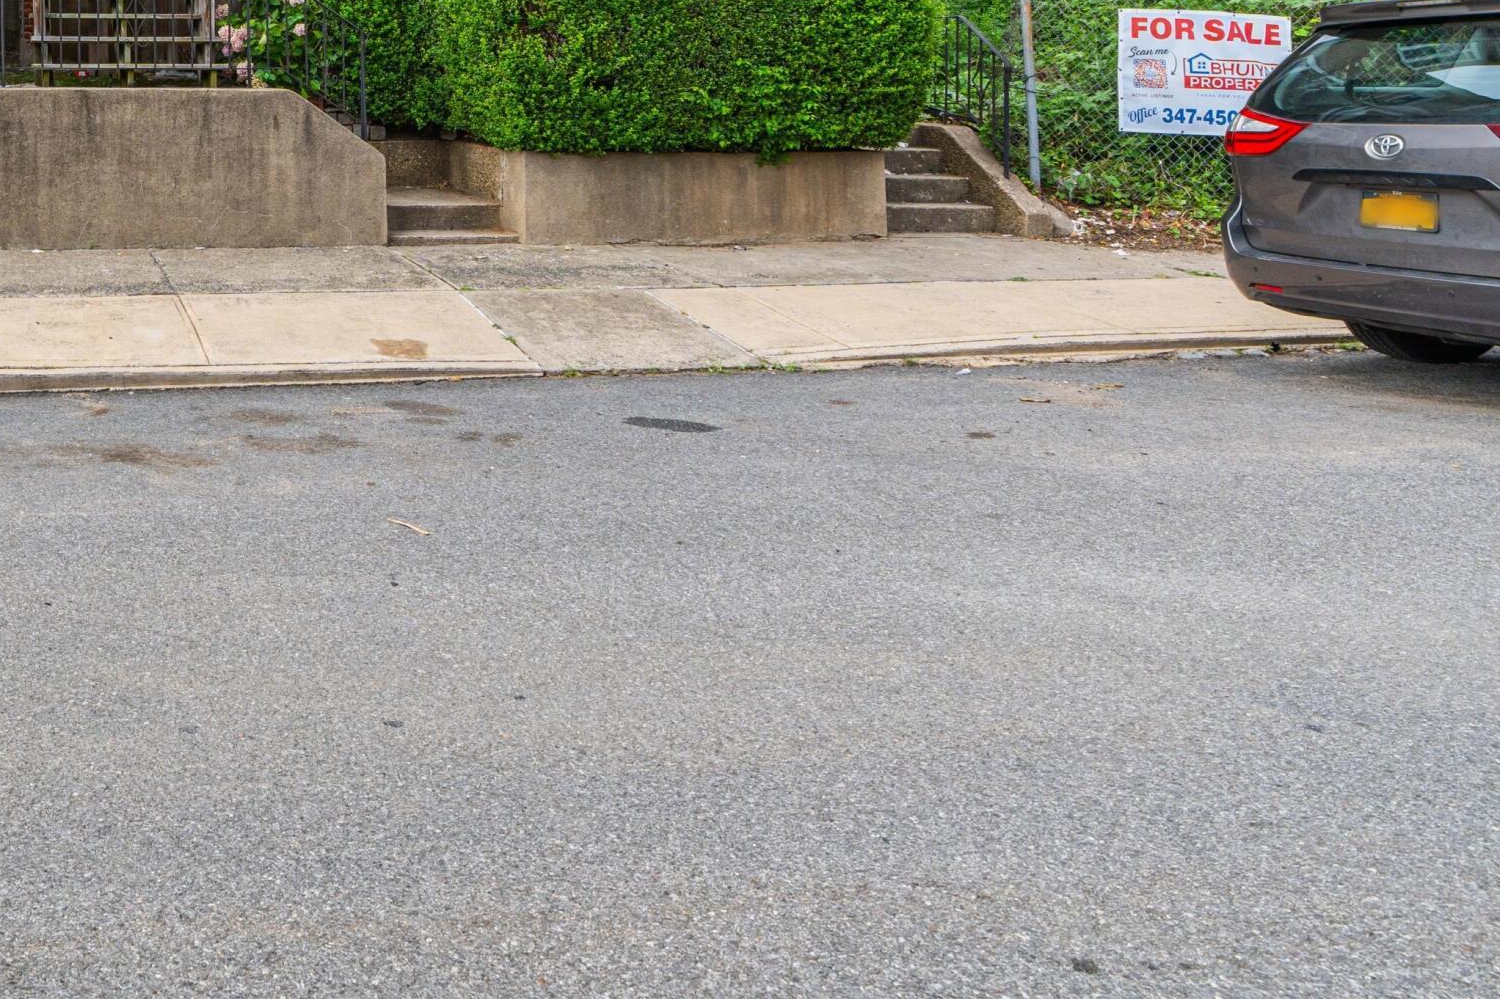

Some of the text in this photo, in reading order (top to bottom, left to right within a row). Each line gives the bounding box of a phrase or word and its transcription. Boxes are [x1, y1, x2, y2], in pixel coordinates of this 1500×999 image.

[1130, 16, 1282, 47] FOR SALE
[1128, 45, 1170, 58] Scan me
[1127, 106, 1158, 124] Office
